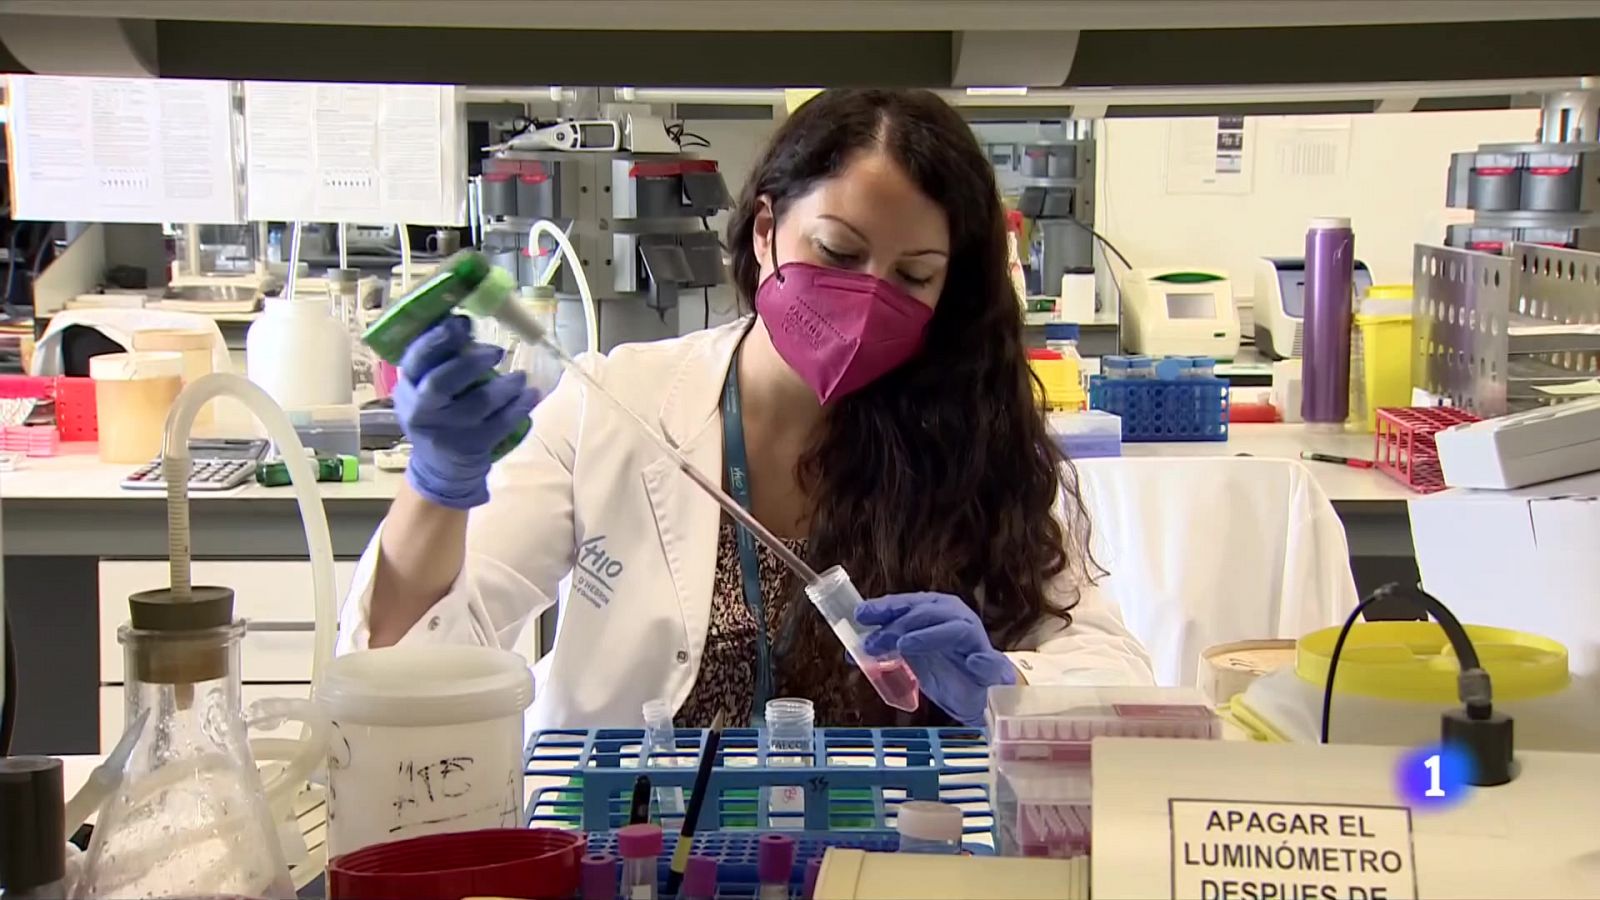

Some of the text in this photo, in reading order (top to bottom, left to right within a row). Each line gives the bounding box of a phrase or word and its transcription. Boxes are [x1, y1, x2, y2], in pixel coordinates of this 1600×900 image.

[1206, 810, 1376, 838] APAGAR EL
[1184, 840, 1402, 874] LUMINÓMETRO
[1201, 880, 1388, 900] DESPUES DE
